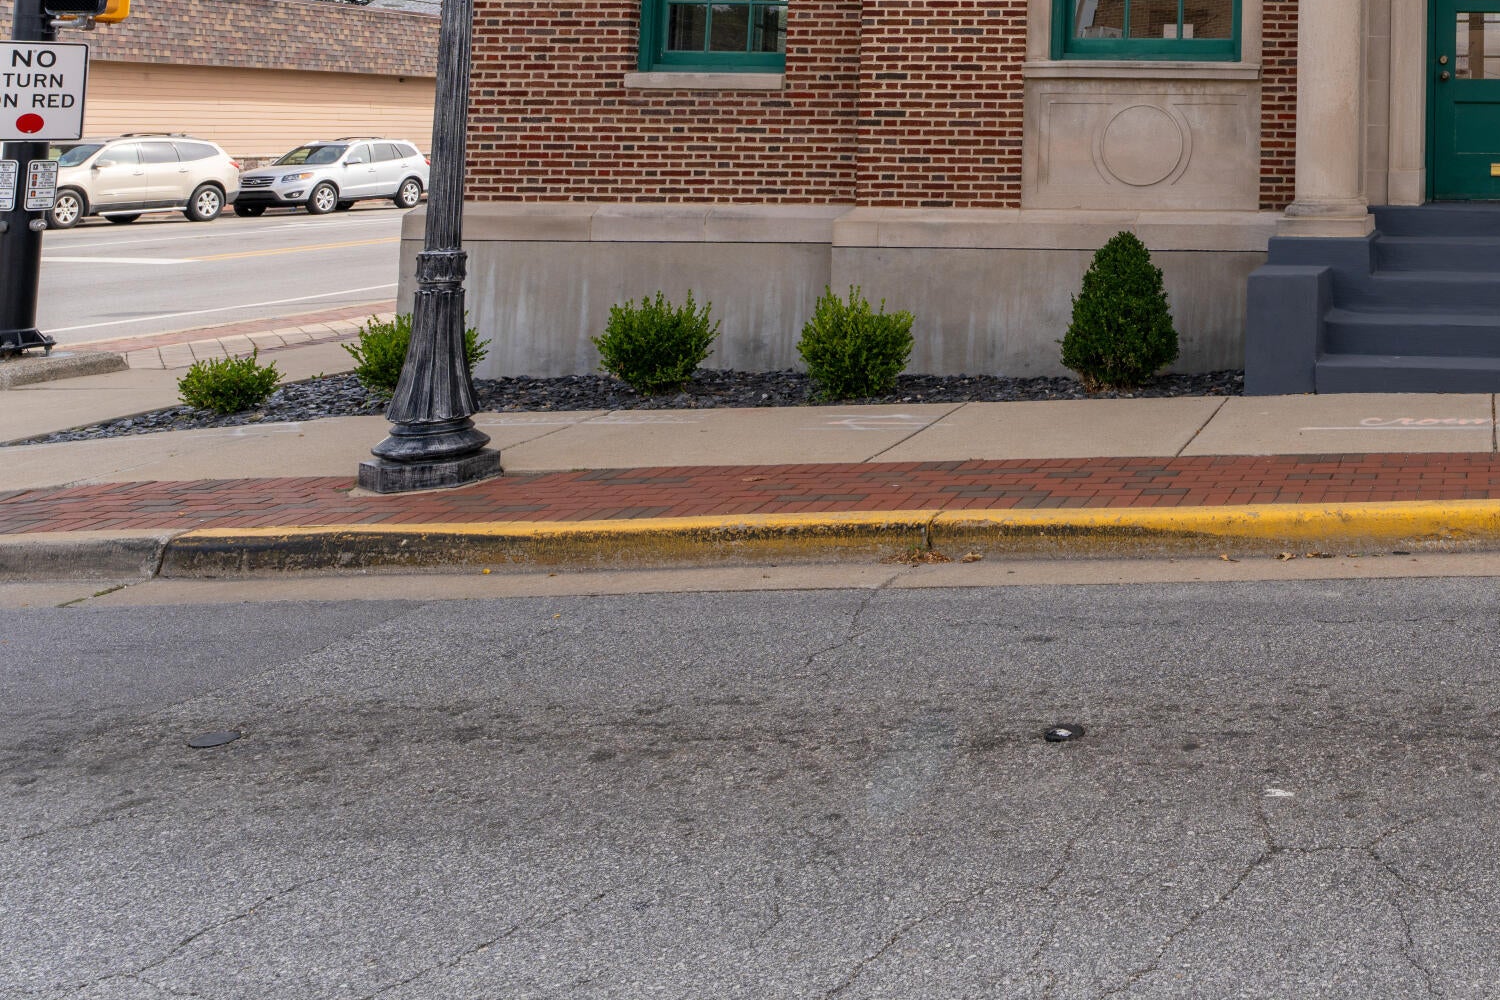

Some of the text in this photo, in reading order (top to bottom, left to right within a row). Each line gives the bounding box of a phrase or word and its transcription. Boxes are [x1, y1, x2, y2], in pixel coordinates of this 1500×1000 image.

[12, 49, 57, 68] NO
[3, 73, 64, 88] TURN
[0, 93, 75, 108] N RED
